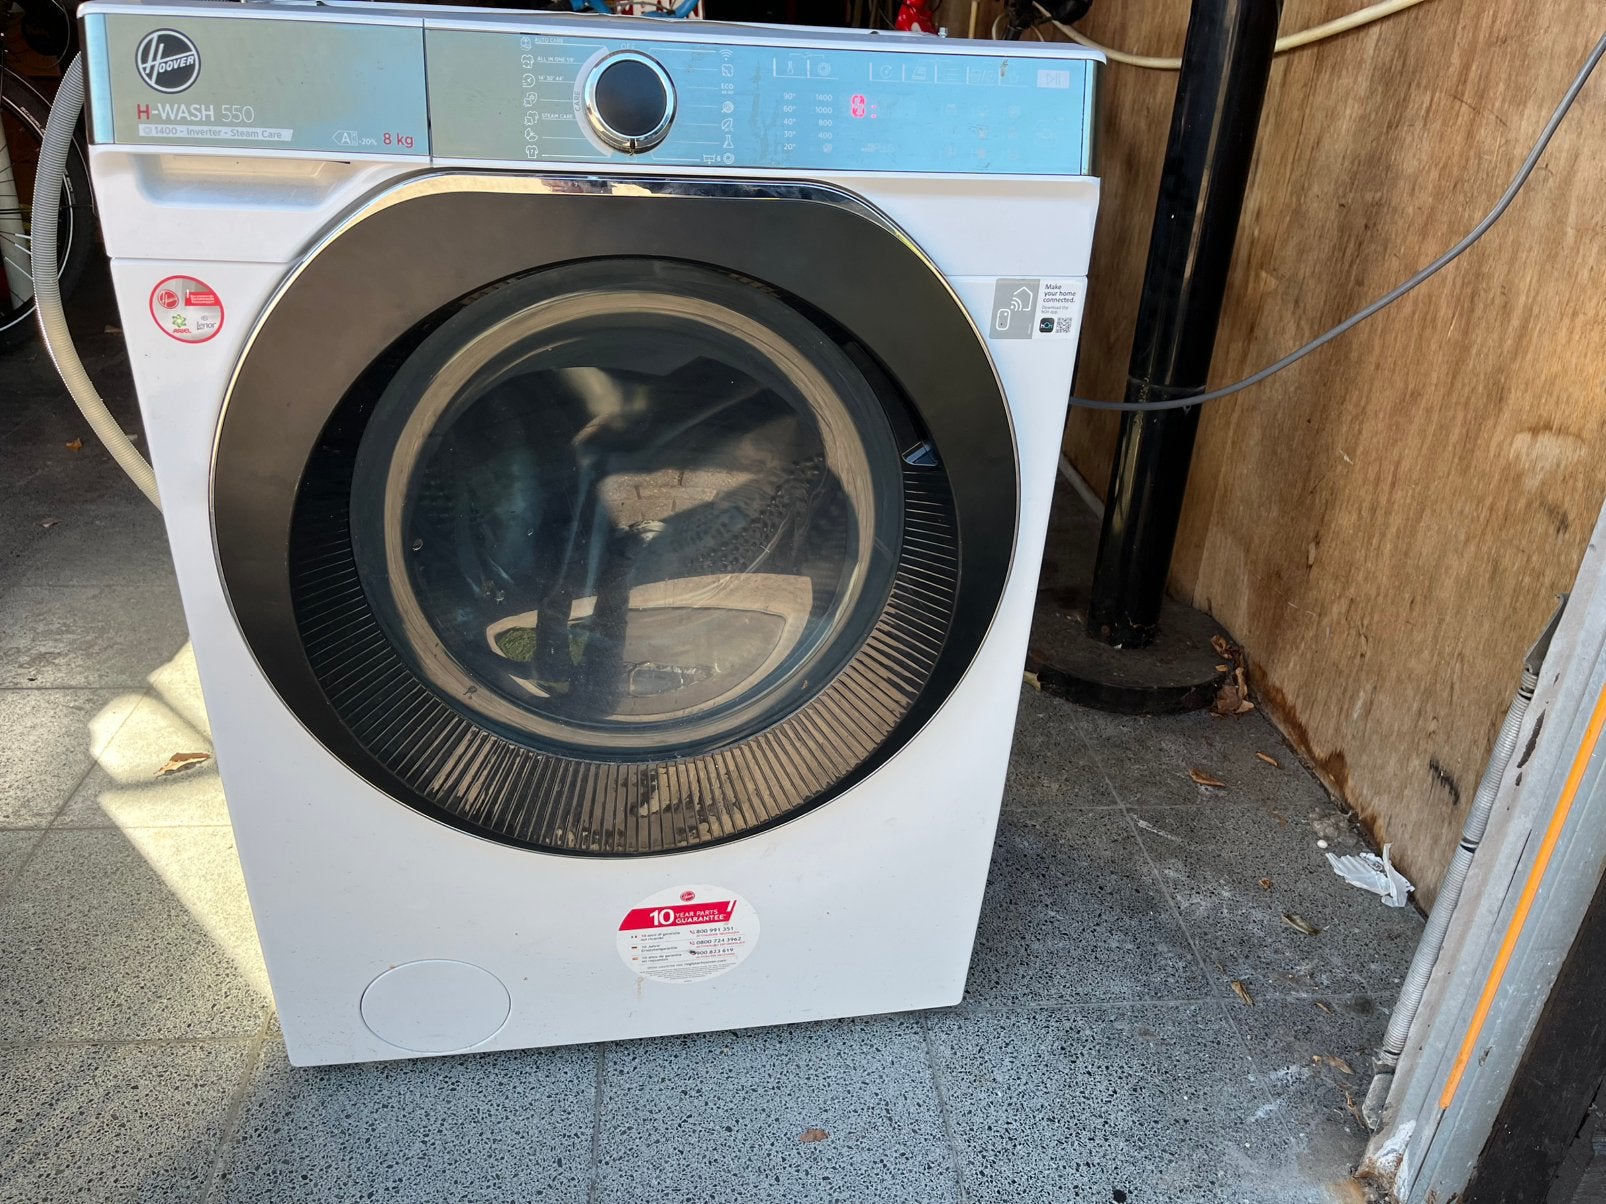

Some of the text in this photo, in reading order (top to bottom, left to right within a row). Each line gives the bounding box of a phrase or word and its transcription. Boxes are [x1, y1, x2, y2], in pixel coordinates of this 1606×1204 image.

[140, 32, 195, 84] HOOVER
[784, 92, 796, 100] 90°
[816, 94, 832, 102] 1400
[137, 103, 255, 123] H-WASH 550
[154, 126, 178, 135] 1400
[186, 128, 222, 136] Inverter
[230, 128, 259, 138] Steam
[261, 130, 282, 139] Care
[383, 132, 414, 148] 8 kg
[196, 320, 216, 332] Lenor
[650, 908, 674, 926] 10
[676, 914, 725, 924] GUARANTEE
